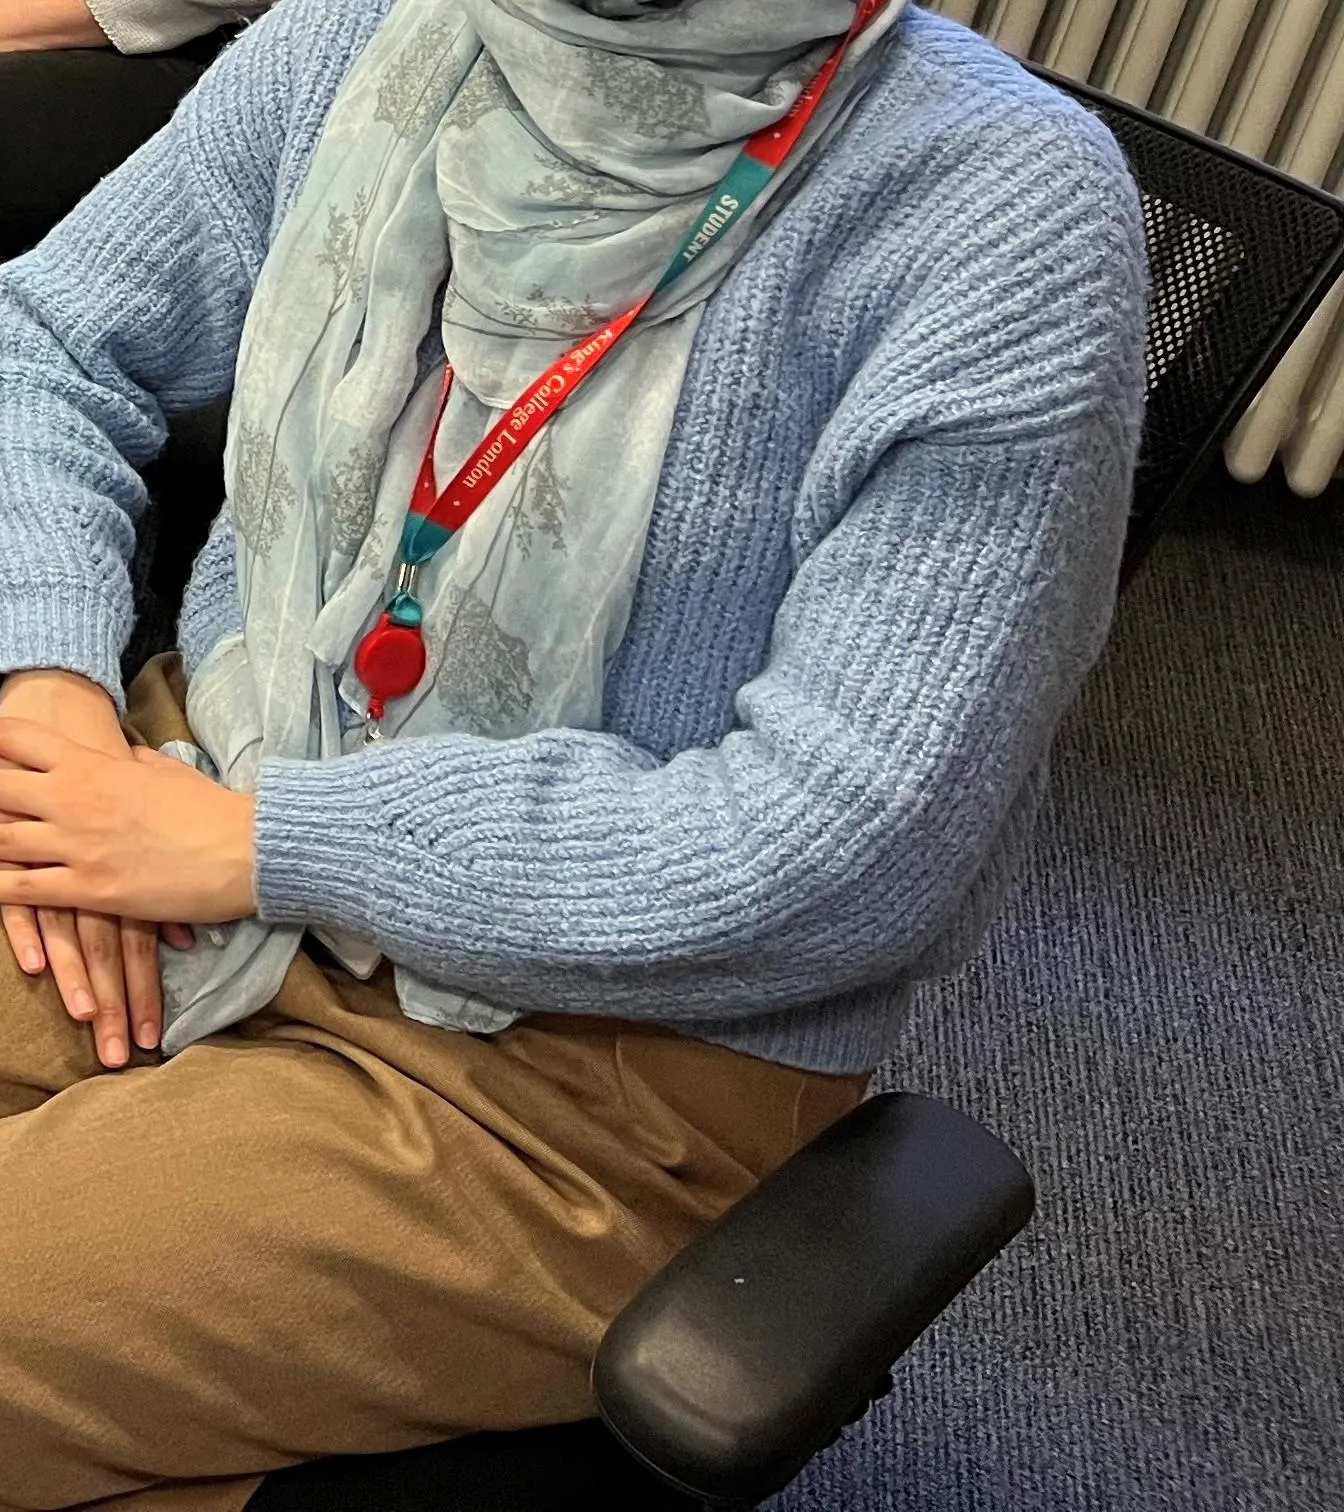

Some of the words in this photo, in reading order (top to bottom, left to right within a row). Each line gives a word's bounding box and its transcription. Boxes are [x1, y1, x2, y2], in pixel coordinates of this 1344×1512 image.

[683, 193, 740, 263] STUDENT
[563, 329, 614, 375] King's
[510, 374, 566, 432] College
[462, 429, 517, 489] London
